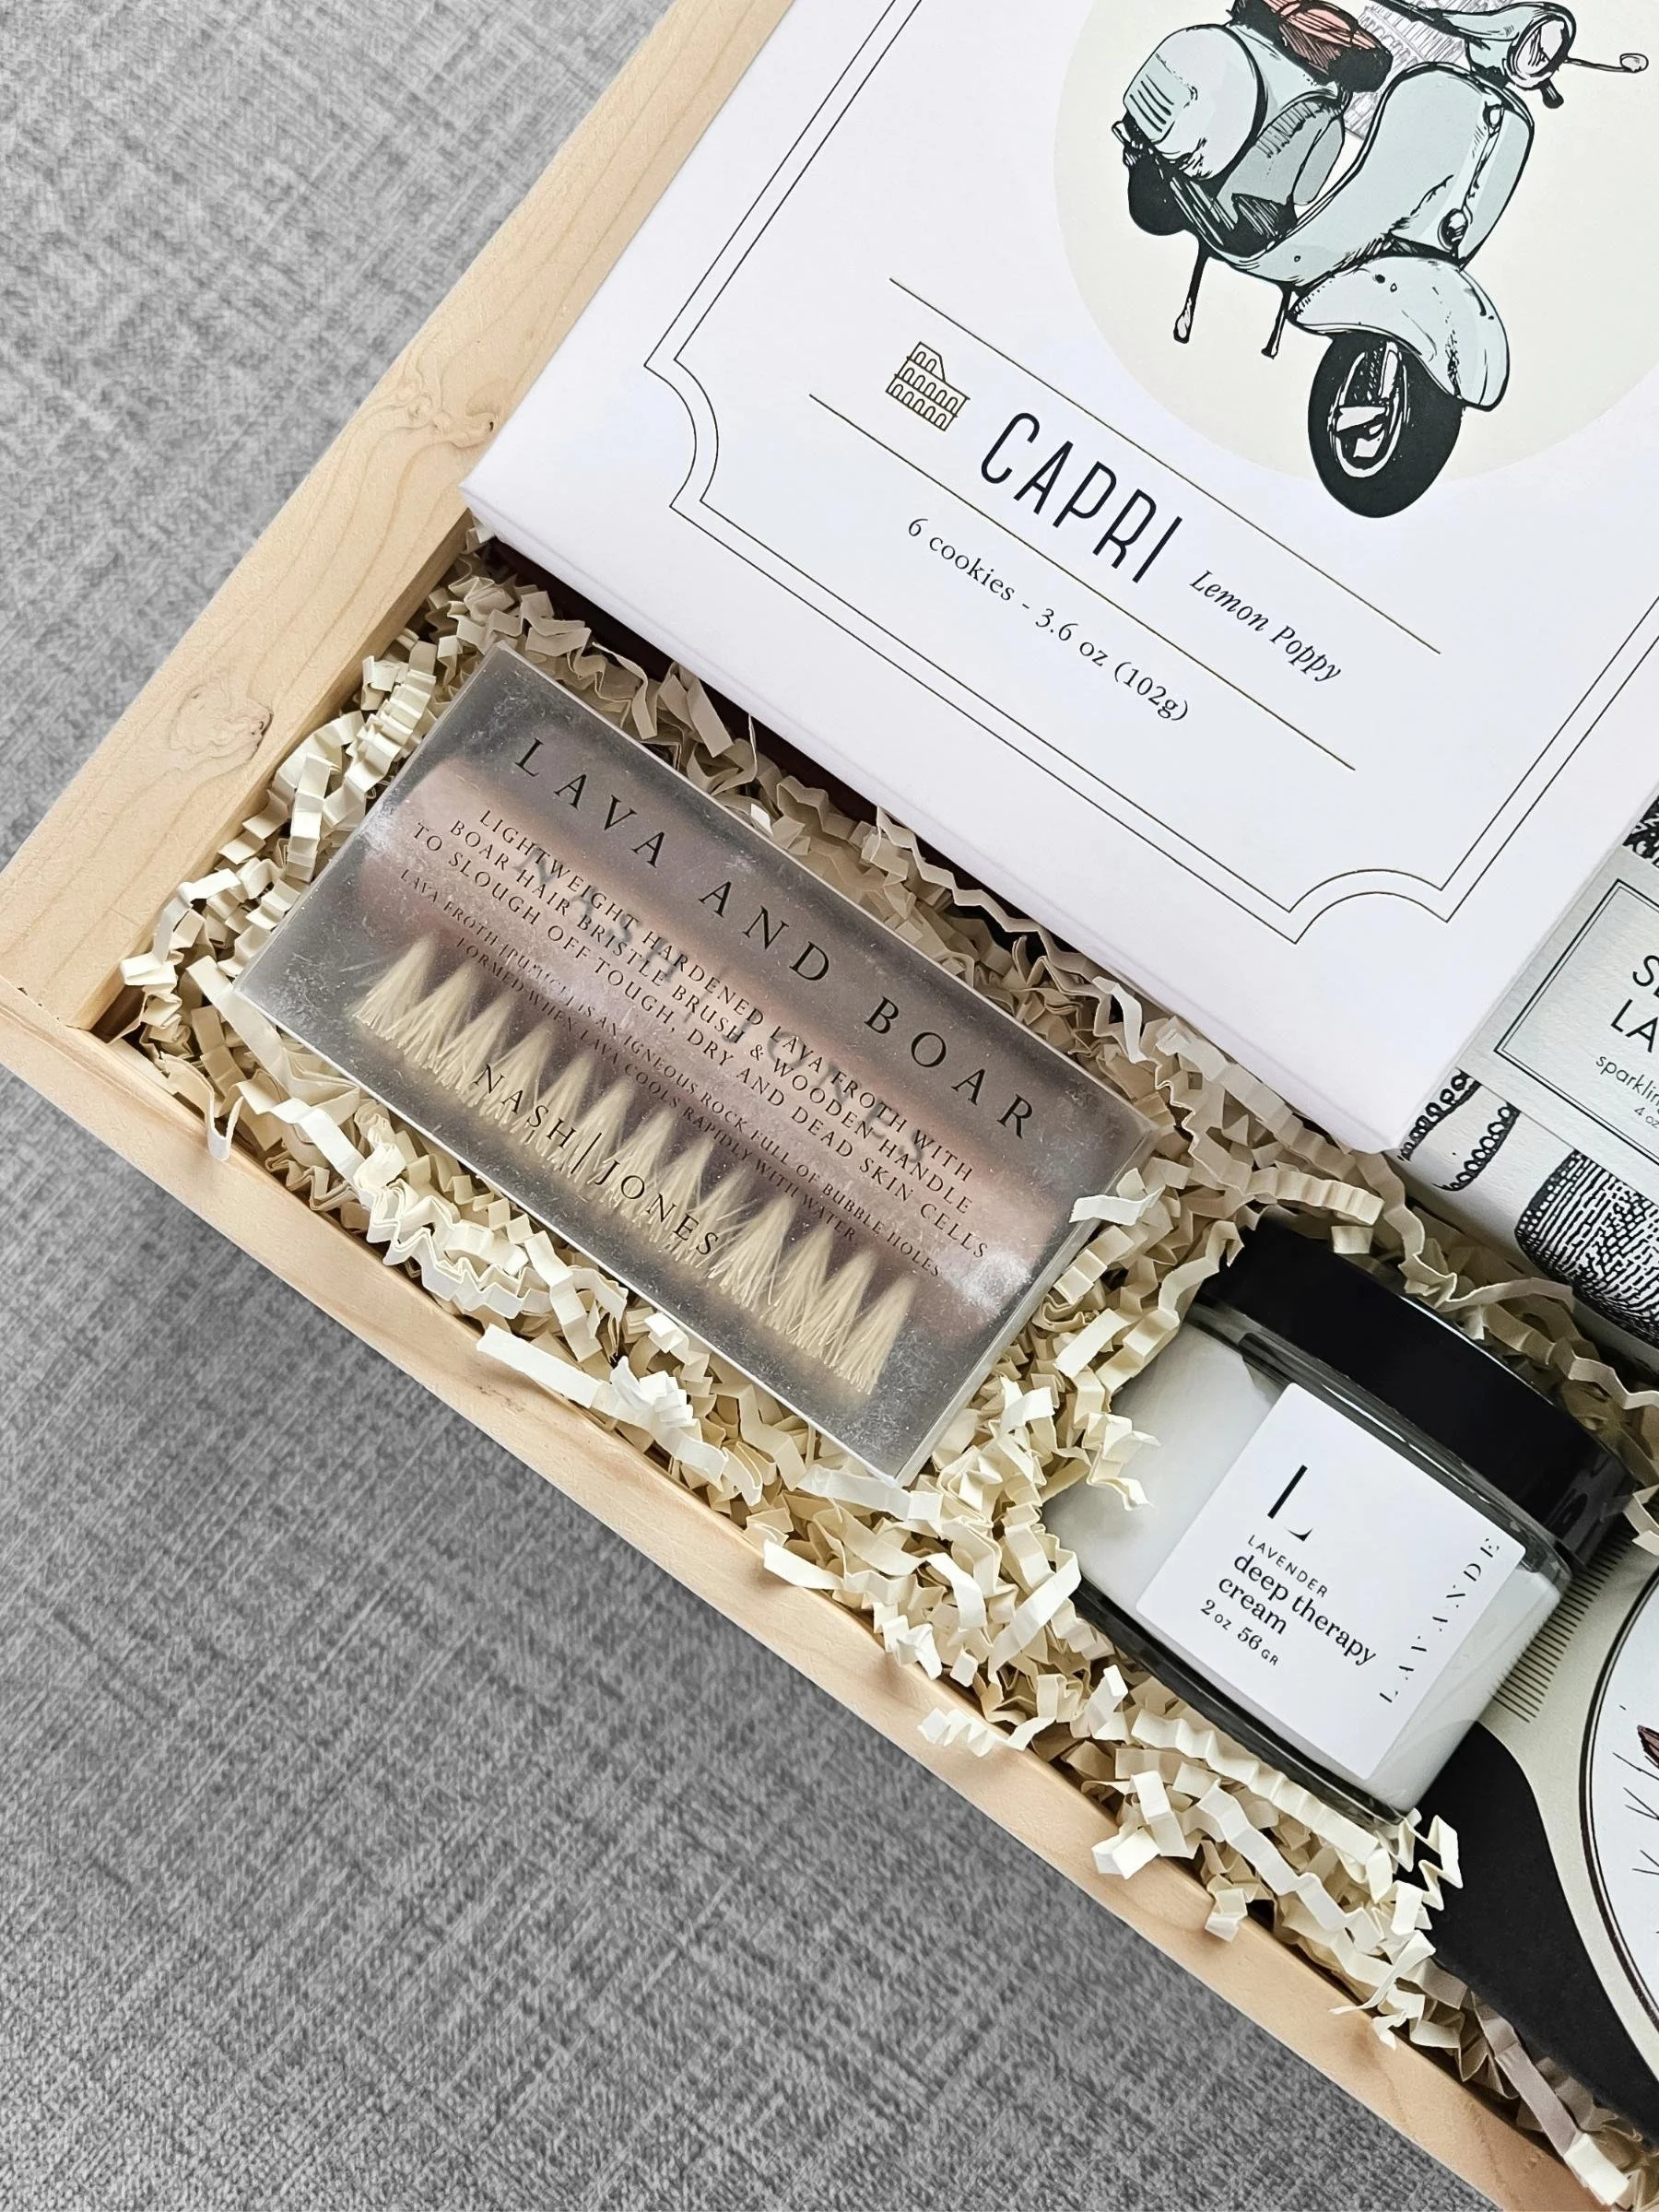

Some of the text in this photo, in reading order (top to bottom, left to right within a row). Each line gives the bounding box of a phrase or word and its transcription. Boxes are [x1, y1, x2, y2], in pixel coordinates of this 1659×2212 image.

[981, 412, 1182, 583] CAPRI
[908, 518, 929, 537] 6
[929, 536, 1015, 602] cookies
[1035, 608, 1078, 642] 3.6
[1079, 641, 1109, 666] oz
[1113, 661, 1188, 723] (102g)
[1190, 570, 1342, 683] Lemon Poppy
[450, 820, 972, 1214] BOAR HAIR BRISTLE BRUSH & WOODEN HANDLE
[480, 810, 972, 1182] LIGHTWEIGHT HARDENED LAVA FROTH WITH
[515, 738, 1032, 1139] LAVA AND BOAR
[1633, 955, 1659, 998] S
[401, 869, 441, 905] LAVA
[443, 901, 499, 946] FROTH
[595, 1014, 621, 1039] AN
[624, 1034, 698, 1094] IGNEOUS
[700, 1091, 747, 1133] ROCK
[751, 1130, 789, 1165] FULL
[796, 1165, 820, 1182] OF
[822, 1183, 885, 1235] BUBBLE
[887, 1230, 939, 1278] HOLES
[414, 822, 987, 1258] TO SLOUGH OFF TOUGH, DRY AND DEAD SKIN CELLS
[457, 937, 526, 992] FORMED
[580, 1030, 618, 1065] LAVA
[625, 1064, 680, 1108] COOLS
[682, 1106, 752, 1160] RAPIDLY
[756, 1159, 799, 1197] WITH
[1596, 1056, 1659, 1113] sparklin
[473, 1064, 576, 1151] NASH
[591, 1159, 722, 1257] JONES
[1200, 1599, 1216, 1616] 2
[1237, 1627, 1263, 1650] 56
[1261, 1649, 1279, 1665] GR
[1218, 1578, 1287, 1635] cream
[1234, 1555, 1376, 1666] deep therapy
[1248, 1535, 1328, 1598] LAVENDER
